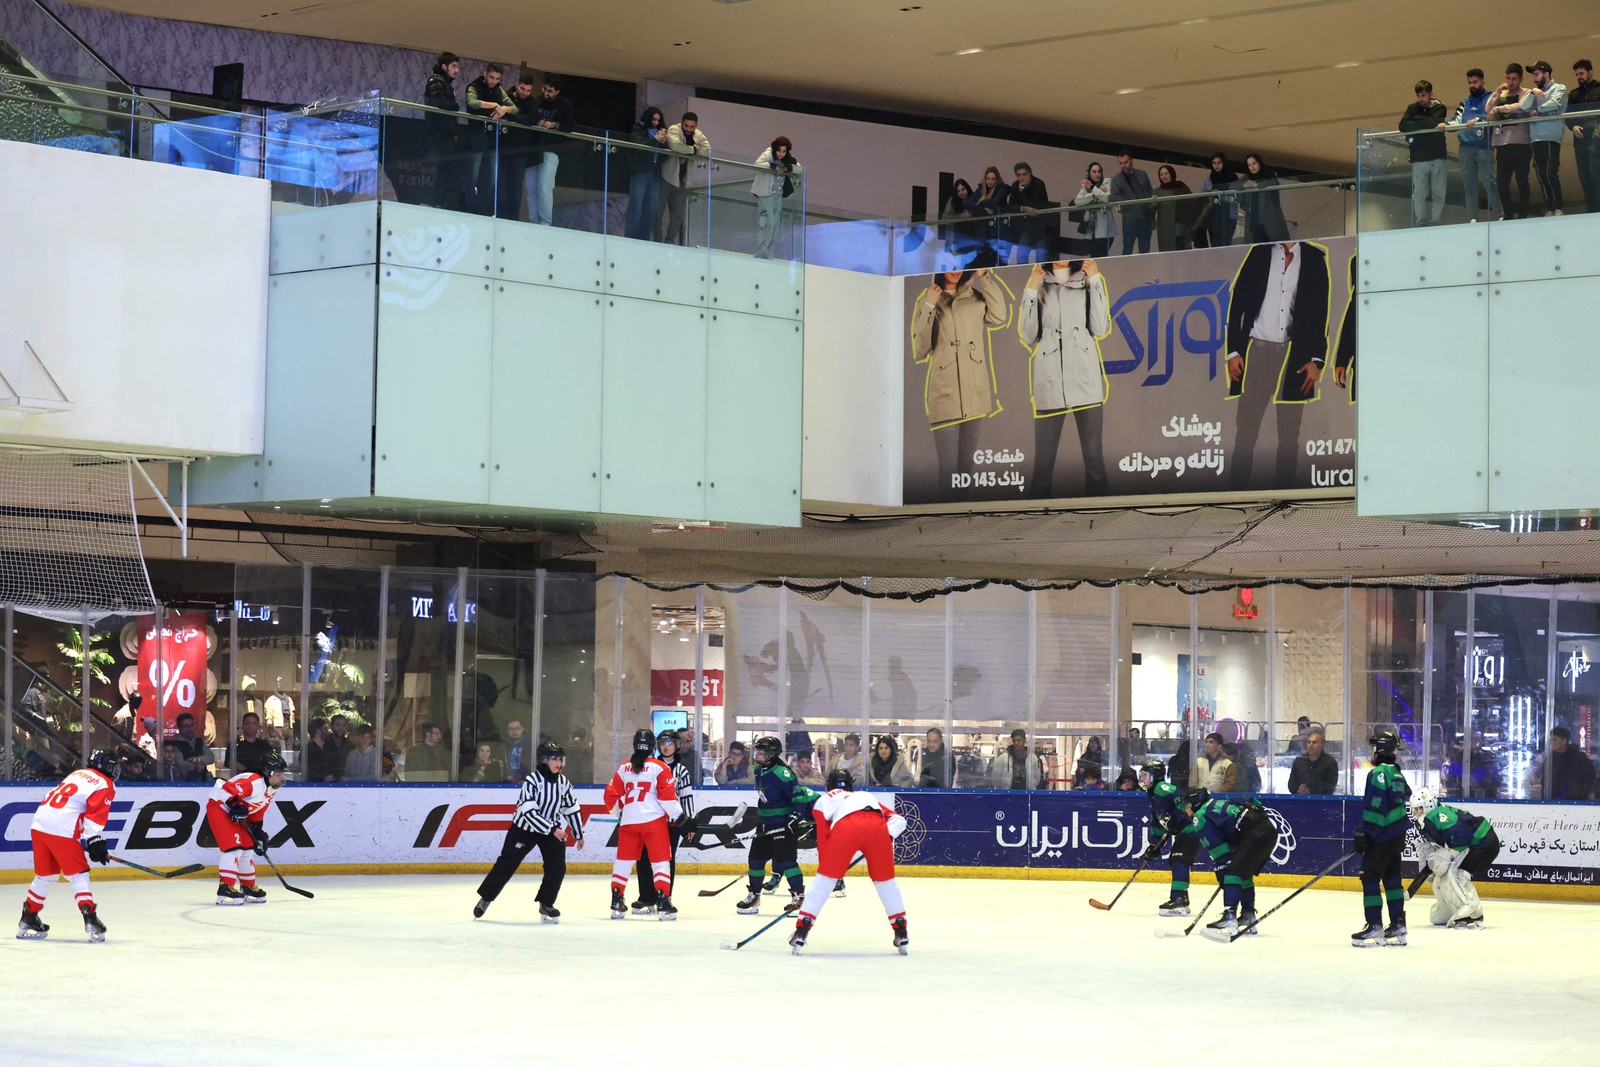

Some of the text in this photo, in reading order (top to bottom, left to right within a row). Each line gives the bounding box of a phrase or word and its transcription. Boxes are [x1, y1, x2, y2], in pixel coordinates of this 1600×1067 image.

[1162, 414, 1221, 445] پوشاک
[973, 449, 1024, 467] طبقه G3
[1119, 448, 1224, 478] زنانه و مردانه
[951, 471, 1025, 492] پلاک RD 143
[680, 678, 720, 697] BEST
[625, 781, 651, 805] 27
[996, 811, 1078, 858] ایران
[1082, 810, 1152, 859] زرگ
[1528, 820, 1538, 832] of
[1554, 820, 1579, 830] Hero
[1582, 821, 1593, 831] in
[234, 833, 241, 844] 2
[1509, 837, 1546, 854] قهرمان
[1549, 838, 1566, 853] یک
[1569, 840, 1600, 855] استان
[1487, 869, 1500, 878] G2
[1502, 868, 1522, 880] طبقه
